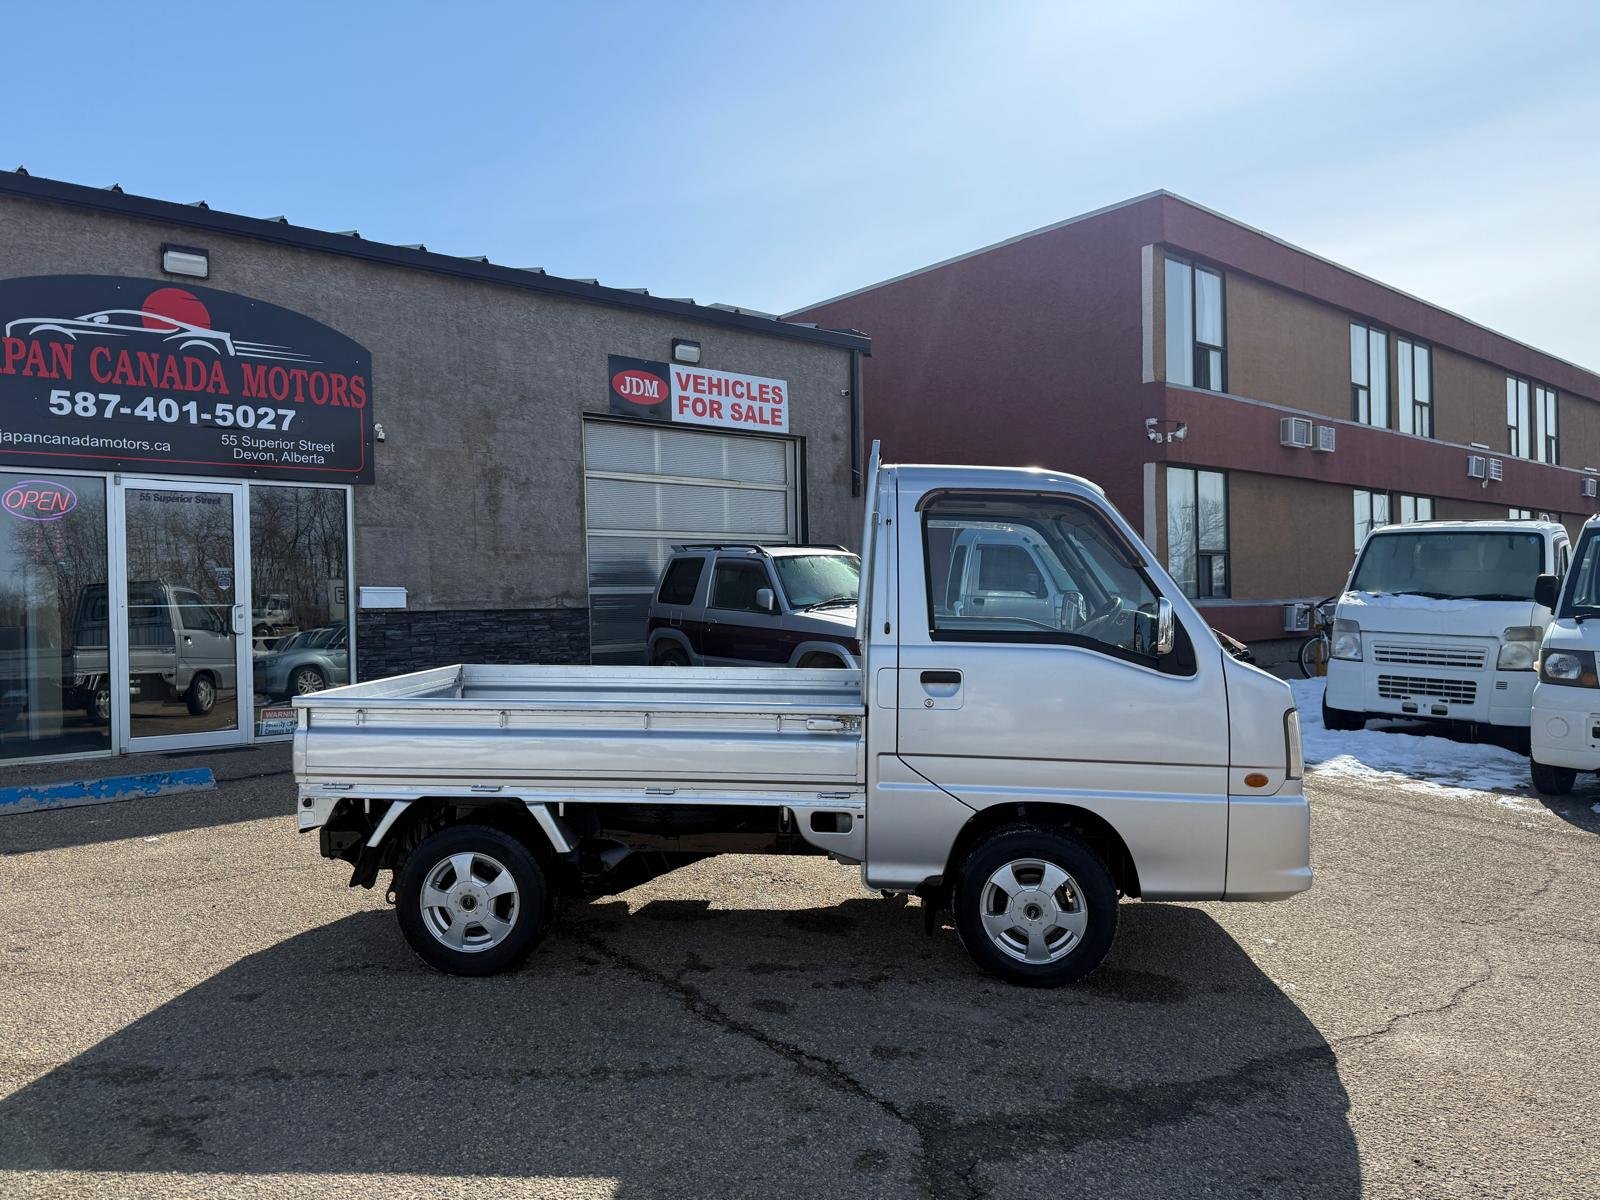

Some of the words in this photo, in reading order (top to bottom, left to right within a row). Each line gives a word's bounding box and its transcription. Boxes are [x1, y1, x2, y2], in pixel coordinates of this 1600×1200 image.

[0, 336, 75, 380] PAN
[89, 346, 230, 395] CANADA
[241, 363, 367, 409] MOTORS
[620, 376, 660, 398] JDM
[675, 372, 784, 405] VEHICLES
[49, 389, 296, 431] 587-401-5027
[678, 395, 723, 419] FOR
[730, 403, 783, 426] SALE
[0, 429, 171, 451] japancanadamotors.ca
[221, 434, 238, 446] 55
[241, 435, 296, 450] Superior
[299, 439, 335, 452] Street
[233, 448, 278, 463] Devon,
[281, 451, 325, 464] Alberta
[6, 490, 70, 511] OPEN
[139, 493, 151, 501] 55
[153, 493, 193, 504] Superior
[195, 495, 221, 505] Street
[265, 710, 297, 719] WARNIN
